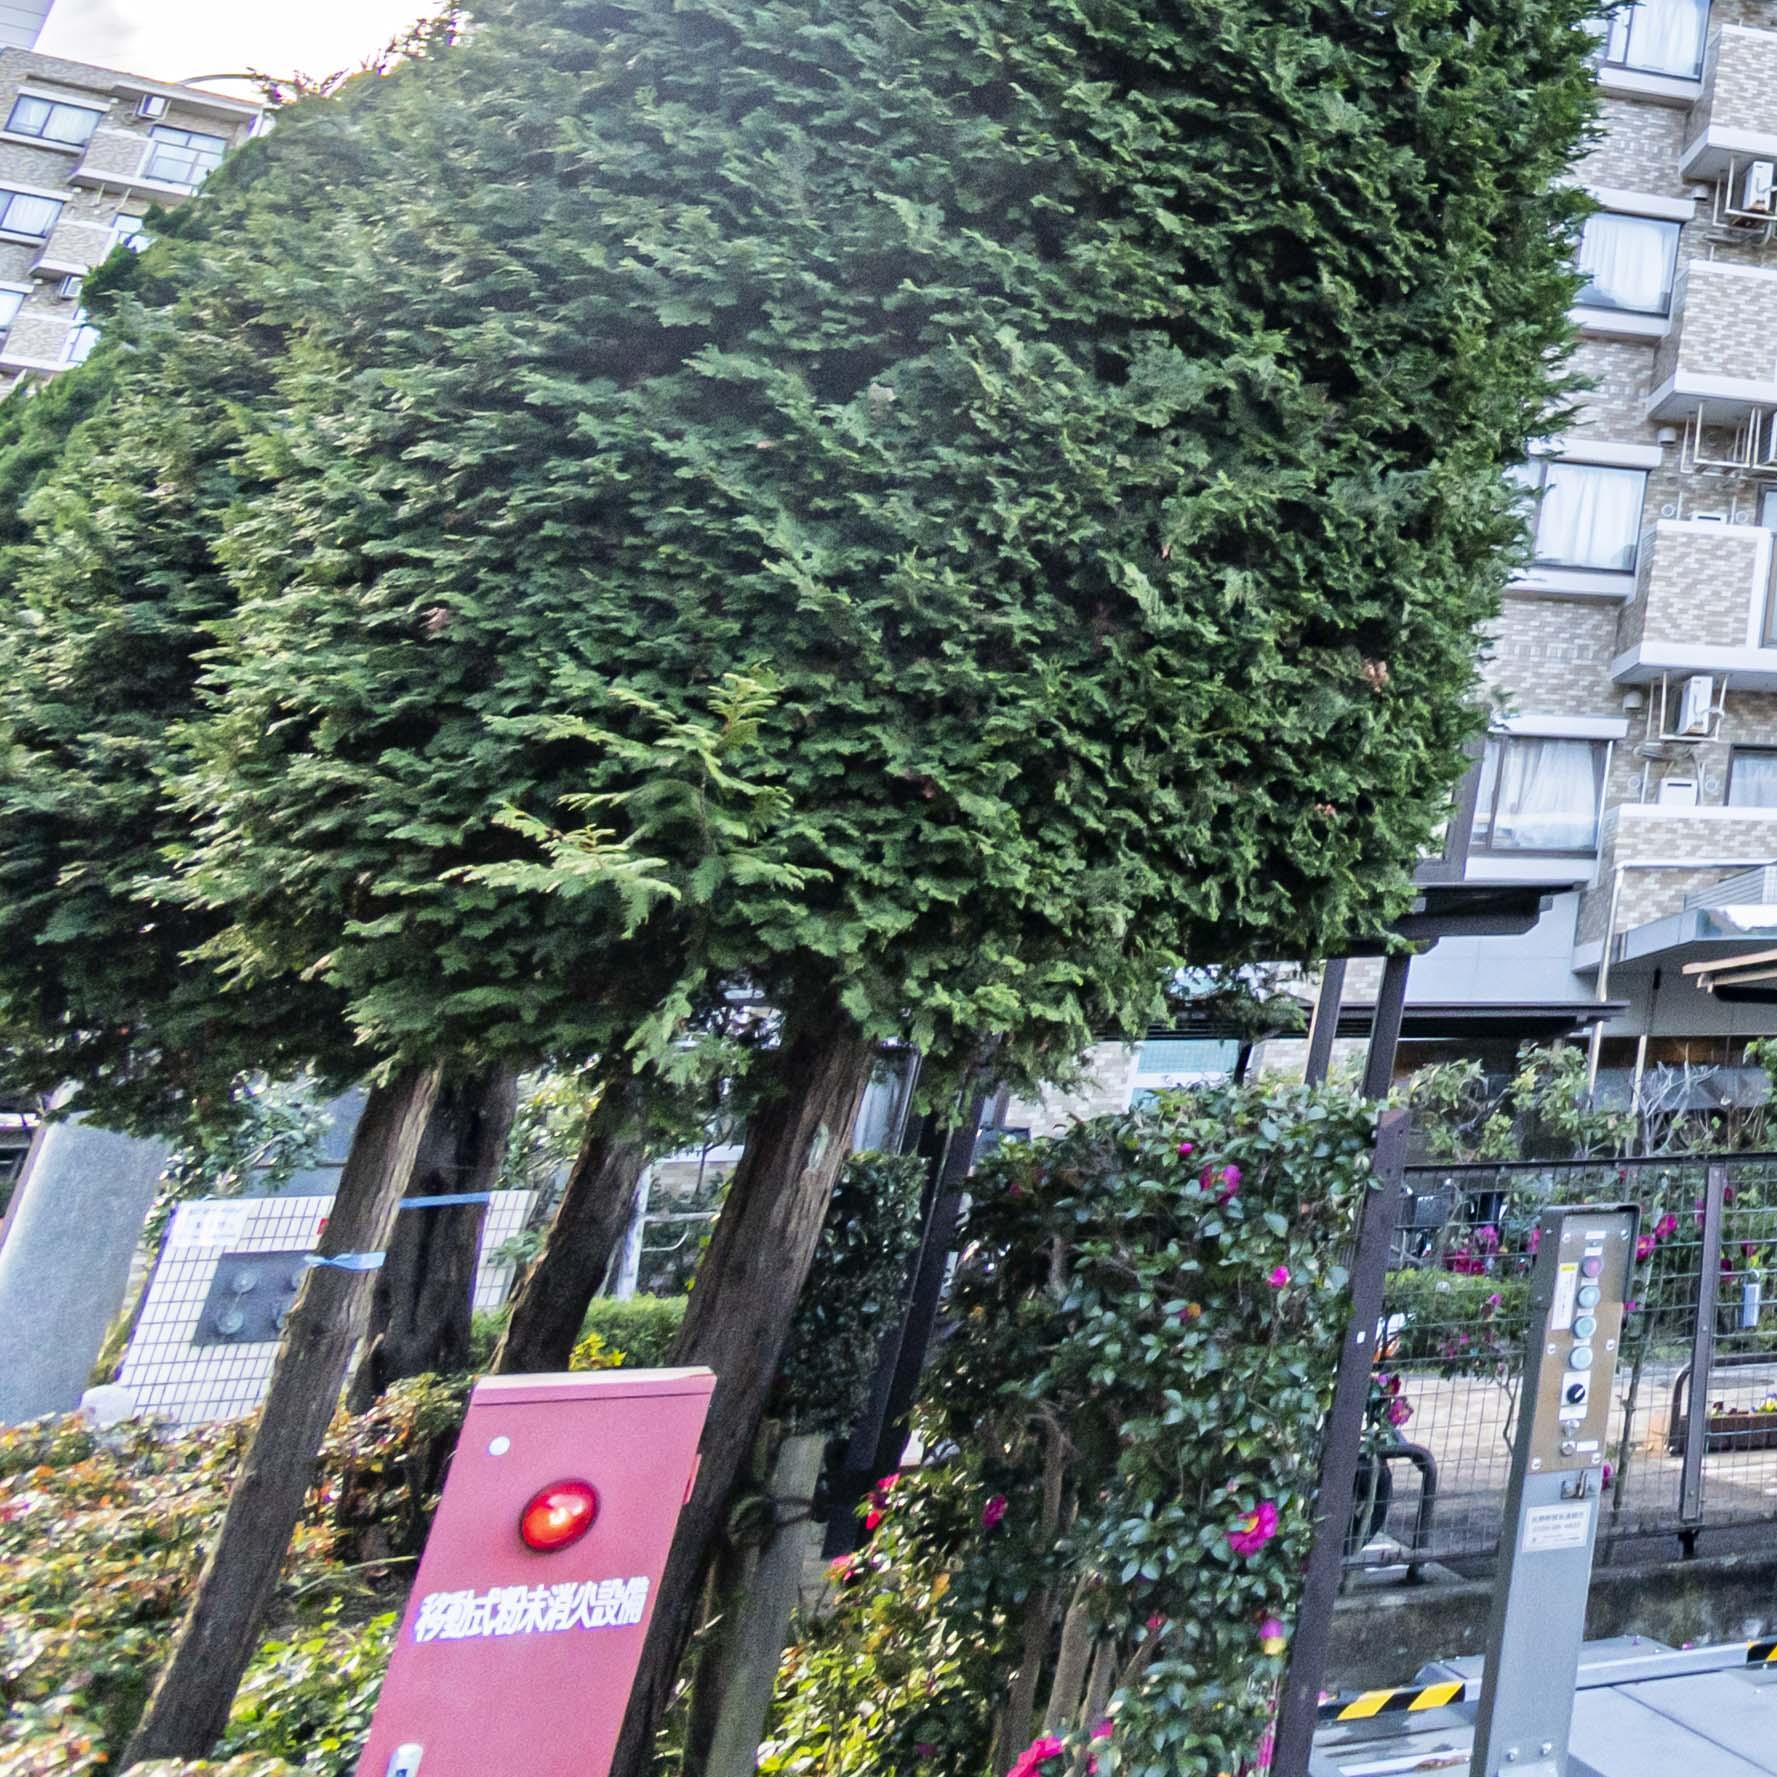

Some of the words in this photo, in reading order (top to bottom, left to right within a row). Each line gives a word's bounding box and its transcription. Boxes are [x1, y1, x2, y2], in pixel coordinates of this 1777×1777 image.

[414, 1575, 651, 1643] 移動式粉末消火設備
